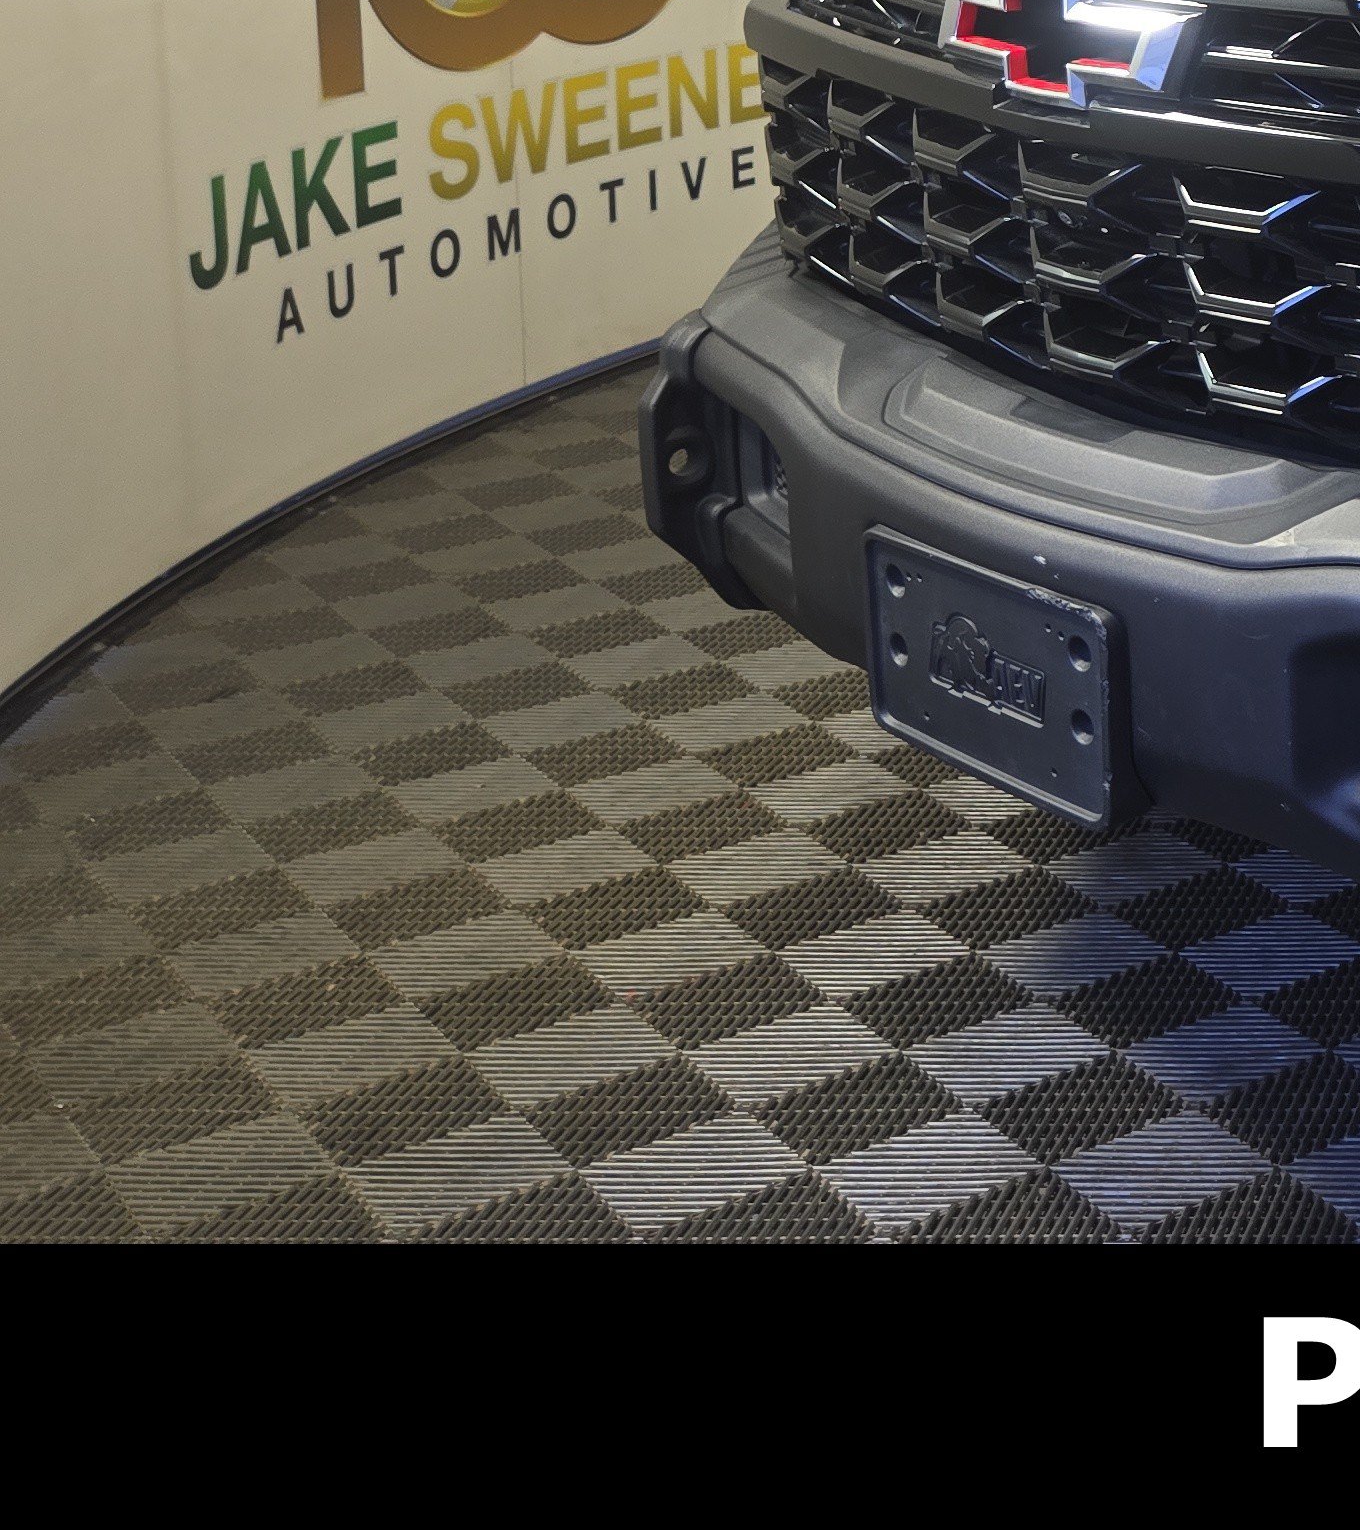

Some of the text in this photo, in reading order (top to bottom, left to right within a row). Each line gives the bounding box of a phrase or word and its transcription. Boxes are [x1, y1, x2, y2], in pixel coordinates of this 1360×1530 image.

[189, 43, 772, 290] JAKE SWEENE
[275, 145, 756, 344] AUTOMOTIVE
